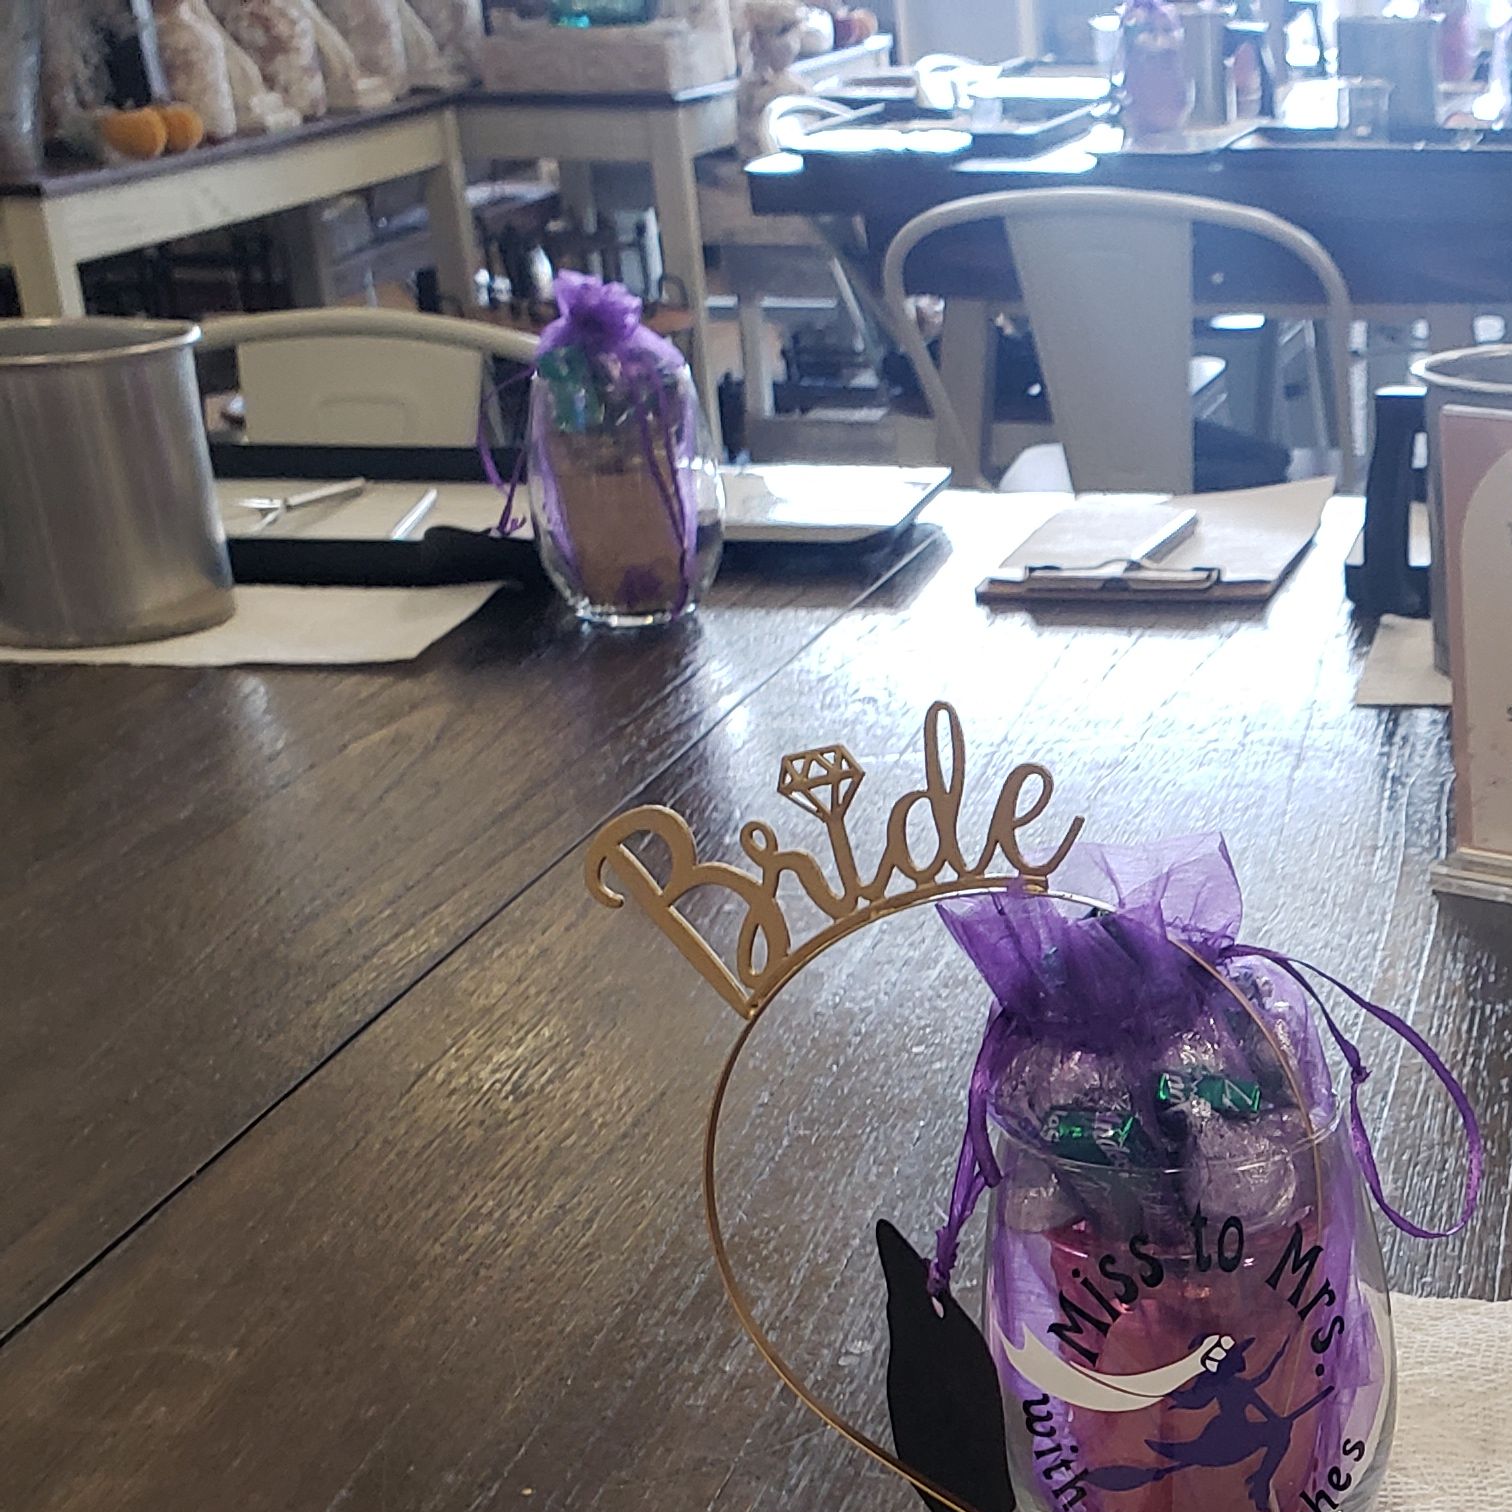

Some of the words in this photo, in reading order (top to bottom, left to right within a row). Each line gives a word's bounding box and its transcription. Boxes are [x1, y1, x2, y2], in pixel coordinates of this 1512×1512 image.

[584, 700, 1086, 1020] Bride
[1046, 1233, 1166, 1367] Miss
[1188, 1203, 1245, 1273] to
[1265, 1225, 1346, 1378] Mrs.
[1022, 1393, 1089, 1512] with
